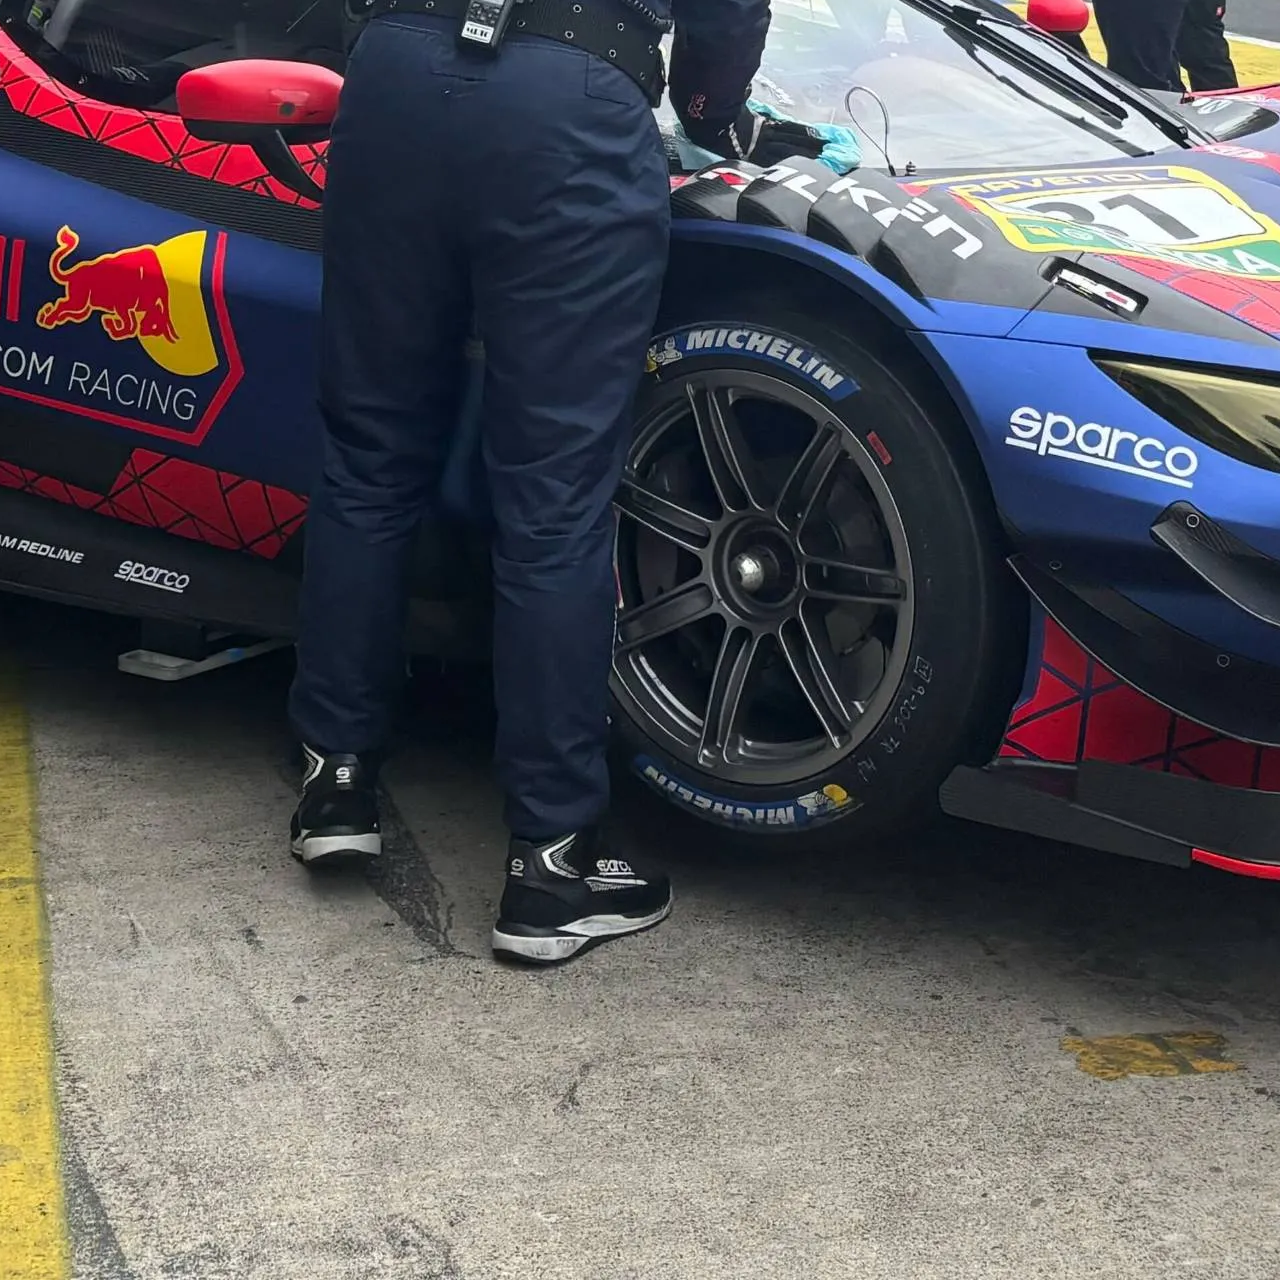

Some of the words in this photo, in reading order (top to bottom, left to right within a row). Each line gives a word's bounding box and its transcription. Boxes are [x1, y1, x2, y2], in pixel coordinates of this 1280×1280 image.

[958, 171, 1172, 199] RAVENOL
[685, 327, 846, 392] MICHELIN
[68, 362, 199, 422] RACING
[1005, 404, 1199, 488] sparco
[14, 538, 84, 565] REDLINE
[114, 559, 191, 594] sparco
[643, 765, 796, 825] MICHELIN
